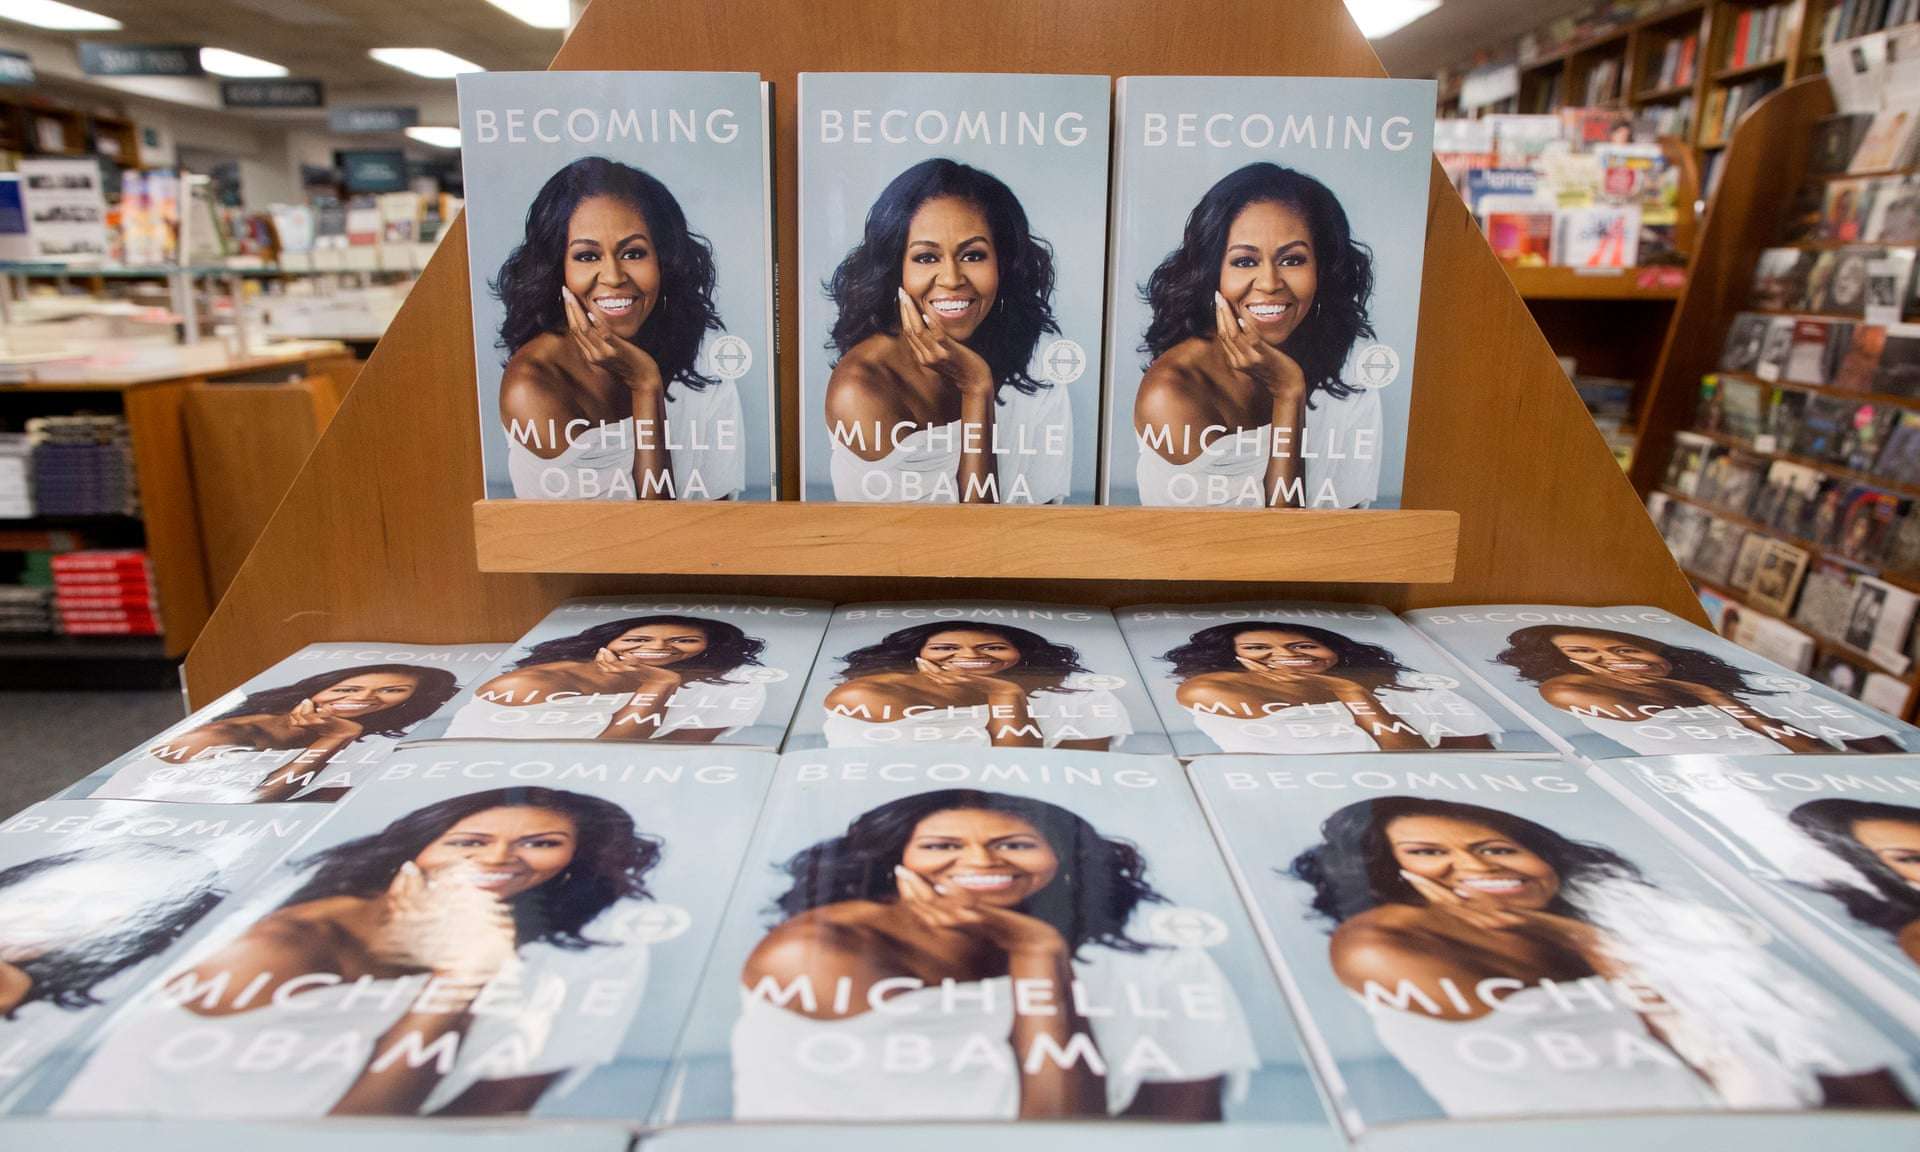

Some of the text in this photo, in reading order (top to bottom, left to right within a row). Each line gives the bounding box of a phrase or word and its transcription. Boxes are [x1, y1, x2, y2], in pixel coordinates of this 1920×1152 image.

[475, 108, 740, 143] BECOMING
[819, 109, 1088, 146] BECOMING
[1143, 113, 1414, 151] BECOMING
[507, 418, 737, 450] MICHELLE
[831, 420, 1065, 455] MICHELLE
[1140, 423, 1378, 460] MICHELLE
[540, 467, 711, 499] OBAMA
[861, 470, 1034, 503] OBAMA
[1167, 474, 1342, 508] OBAMA
[565, 603, 809, 617] BECOMING
[846, 608, 1093, 622] BECOMING
[1133, 608, 1377, 622] BECOMING
[1429, 612, 1674, 625] BECOMING
[298, 650, 503, 662] BECOMIN
[477, 690, 758, 711] MICHELLE
[833, 703, 1120, 719] MICHELLE
[1192, 701, 1476, 718] MICHELLE
[1568, 704, 1855, 720] MICHELLE
[489, 710, 706, 728] OBAMA
[1242, 719, 1459, 738] OBAMA
[862, 725, 1089, 742] OBAMA
[1633, 725, 1860, 740] OBAMA
[149, 745, 382, 764] MICHELL
[149, 768, 353, 788] OBAMA
[378, 760, 739, 785] BECOMING
[795, 762, 1158, 789] BECOMING
[1223, 770, 1580, 793] BECOMING
[5, 815, 302, 838] BECOMIN
[160, 971, 627, 1016] MICHELE
[746, 975, 1227, 1019] MICHELLE
[1360, 977, 1680, 1016] MICHE
[148, 1028, 528, 1074] OBAMA
[799, 1031, 1183, 1075] OBAMA
